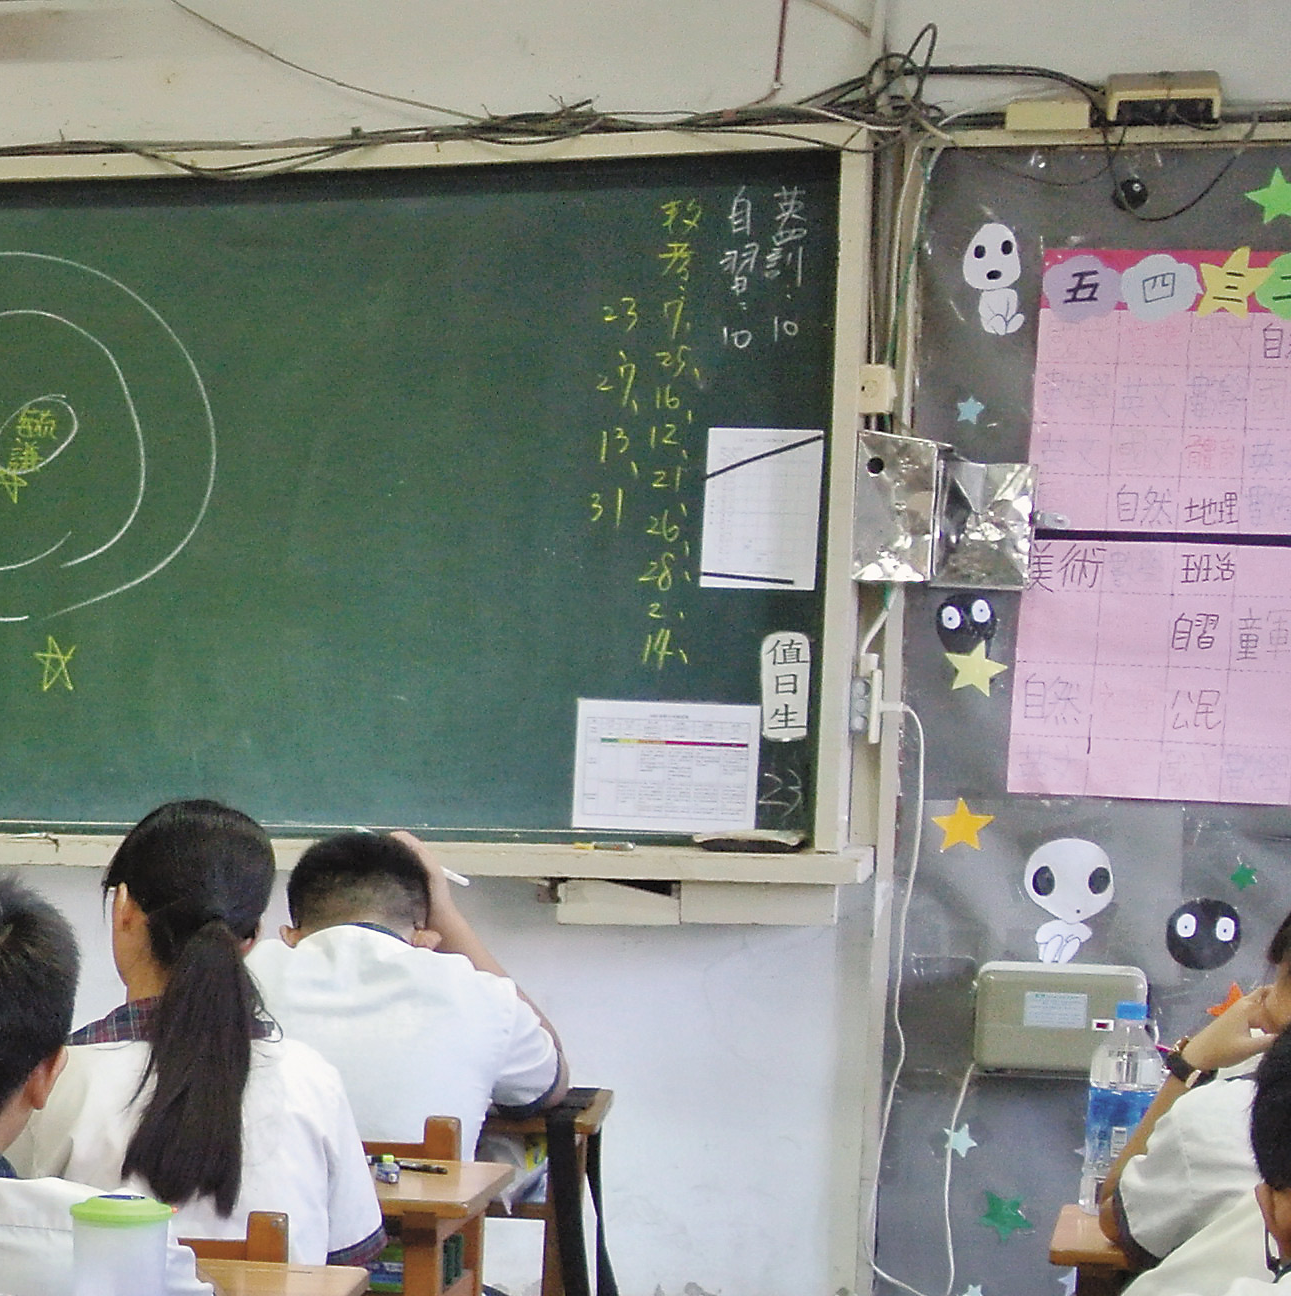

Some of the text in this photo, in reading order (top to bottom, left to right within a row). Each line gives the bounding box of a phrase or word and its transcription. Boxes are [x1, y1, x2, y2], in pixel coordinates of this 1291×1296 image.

[1063, 270, 1100, 303] 五
[1142, 272, 1176, 303] 四
[1213, 271, 1245, 302] 三
[723, 326, 752, 349] 10
[773, 316, 798, 342] 10
[590, 488, 624, 527] 31
[1116, 483, 1173, 527] 自然
[1184, 491, 1239, 526] 地理
[1029, 543, 1107, 593] 美術
[1171, 612, 1220, 651] 自習
[766, 638, 809, 731] 值日生
[1024, 672, 1082, 726] 自然
[1171, 689, 1222, 731] 公民
